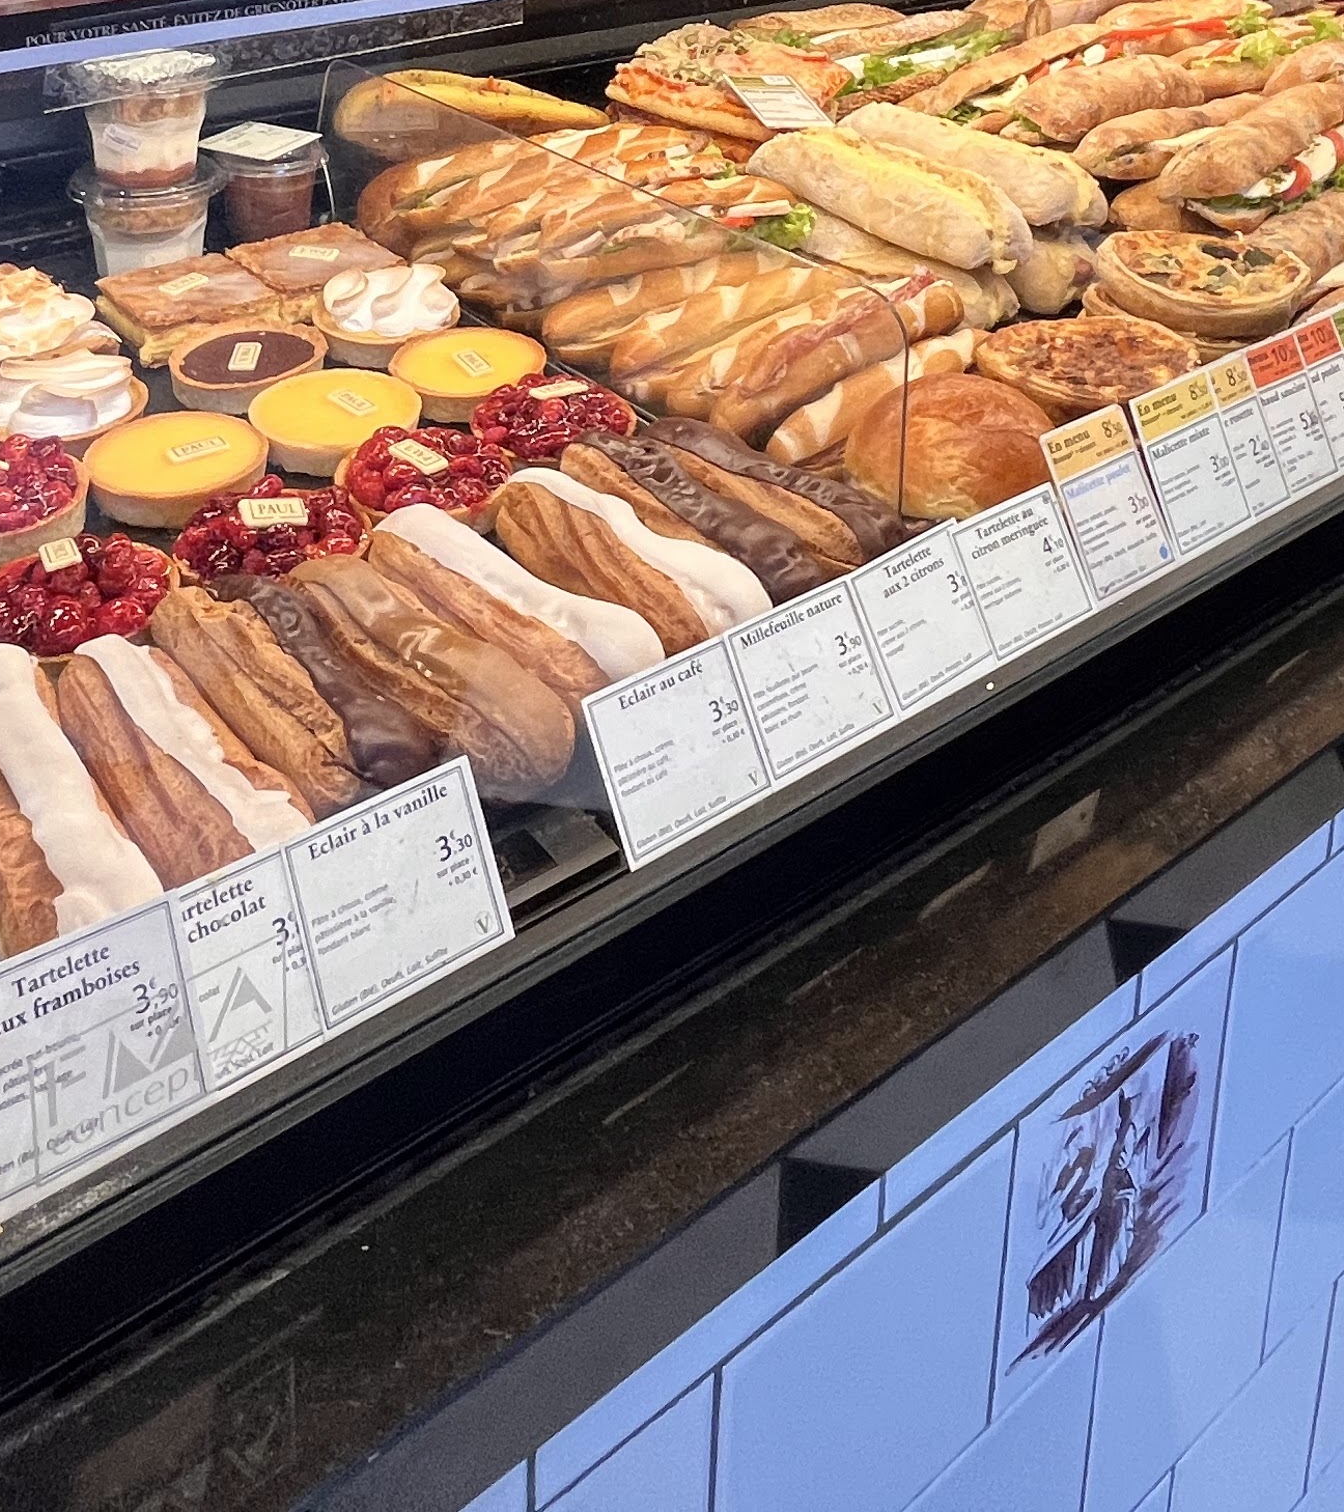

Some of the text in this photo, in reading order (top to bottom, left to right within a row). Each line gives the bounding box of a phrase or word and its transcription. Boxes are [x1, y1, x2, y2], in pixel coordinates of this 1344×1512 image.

[257, 503, 297, 515] PAUL
[974, 506, 1034, 541] Tartelette au
[883, 545, 933, 579] Tartelette
[971, 540, 1001, 561] citron
[1000, 516, 1050, 547] meringuée
[882, 556, 945, 599] aux 2 citrons
[739, 592, 844, 651] Millefeuille nature
[617, 659, 704, 711] Eclair au café
[307, 784, 449, 861] Eclair à la vanille
[187, 895, 267, 944] chocolat
[11, 945, 111, 999] Tartelette
[32, 959, 141, 1021] framboises
